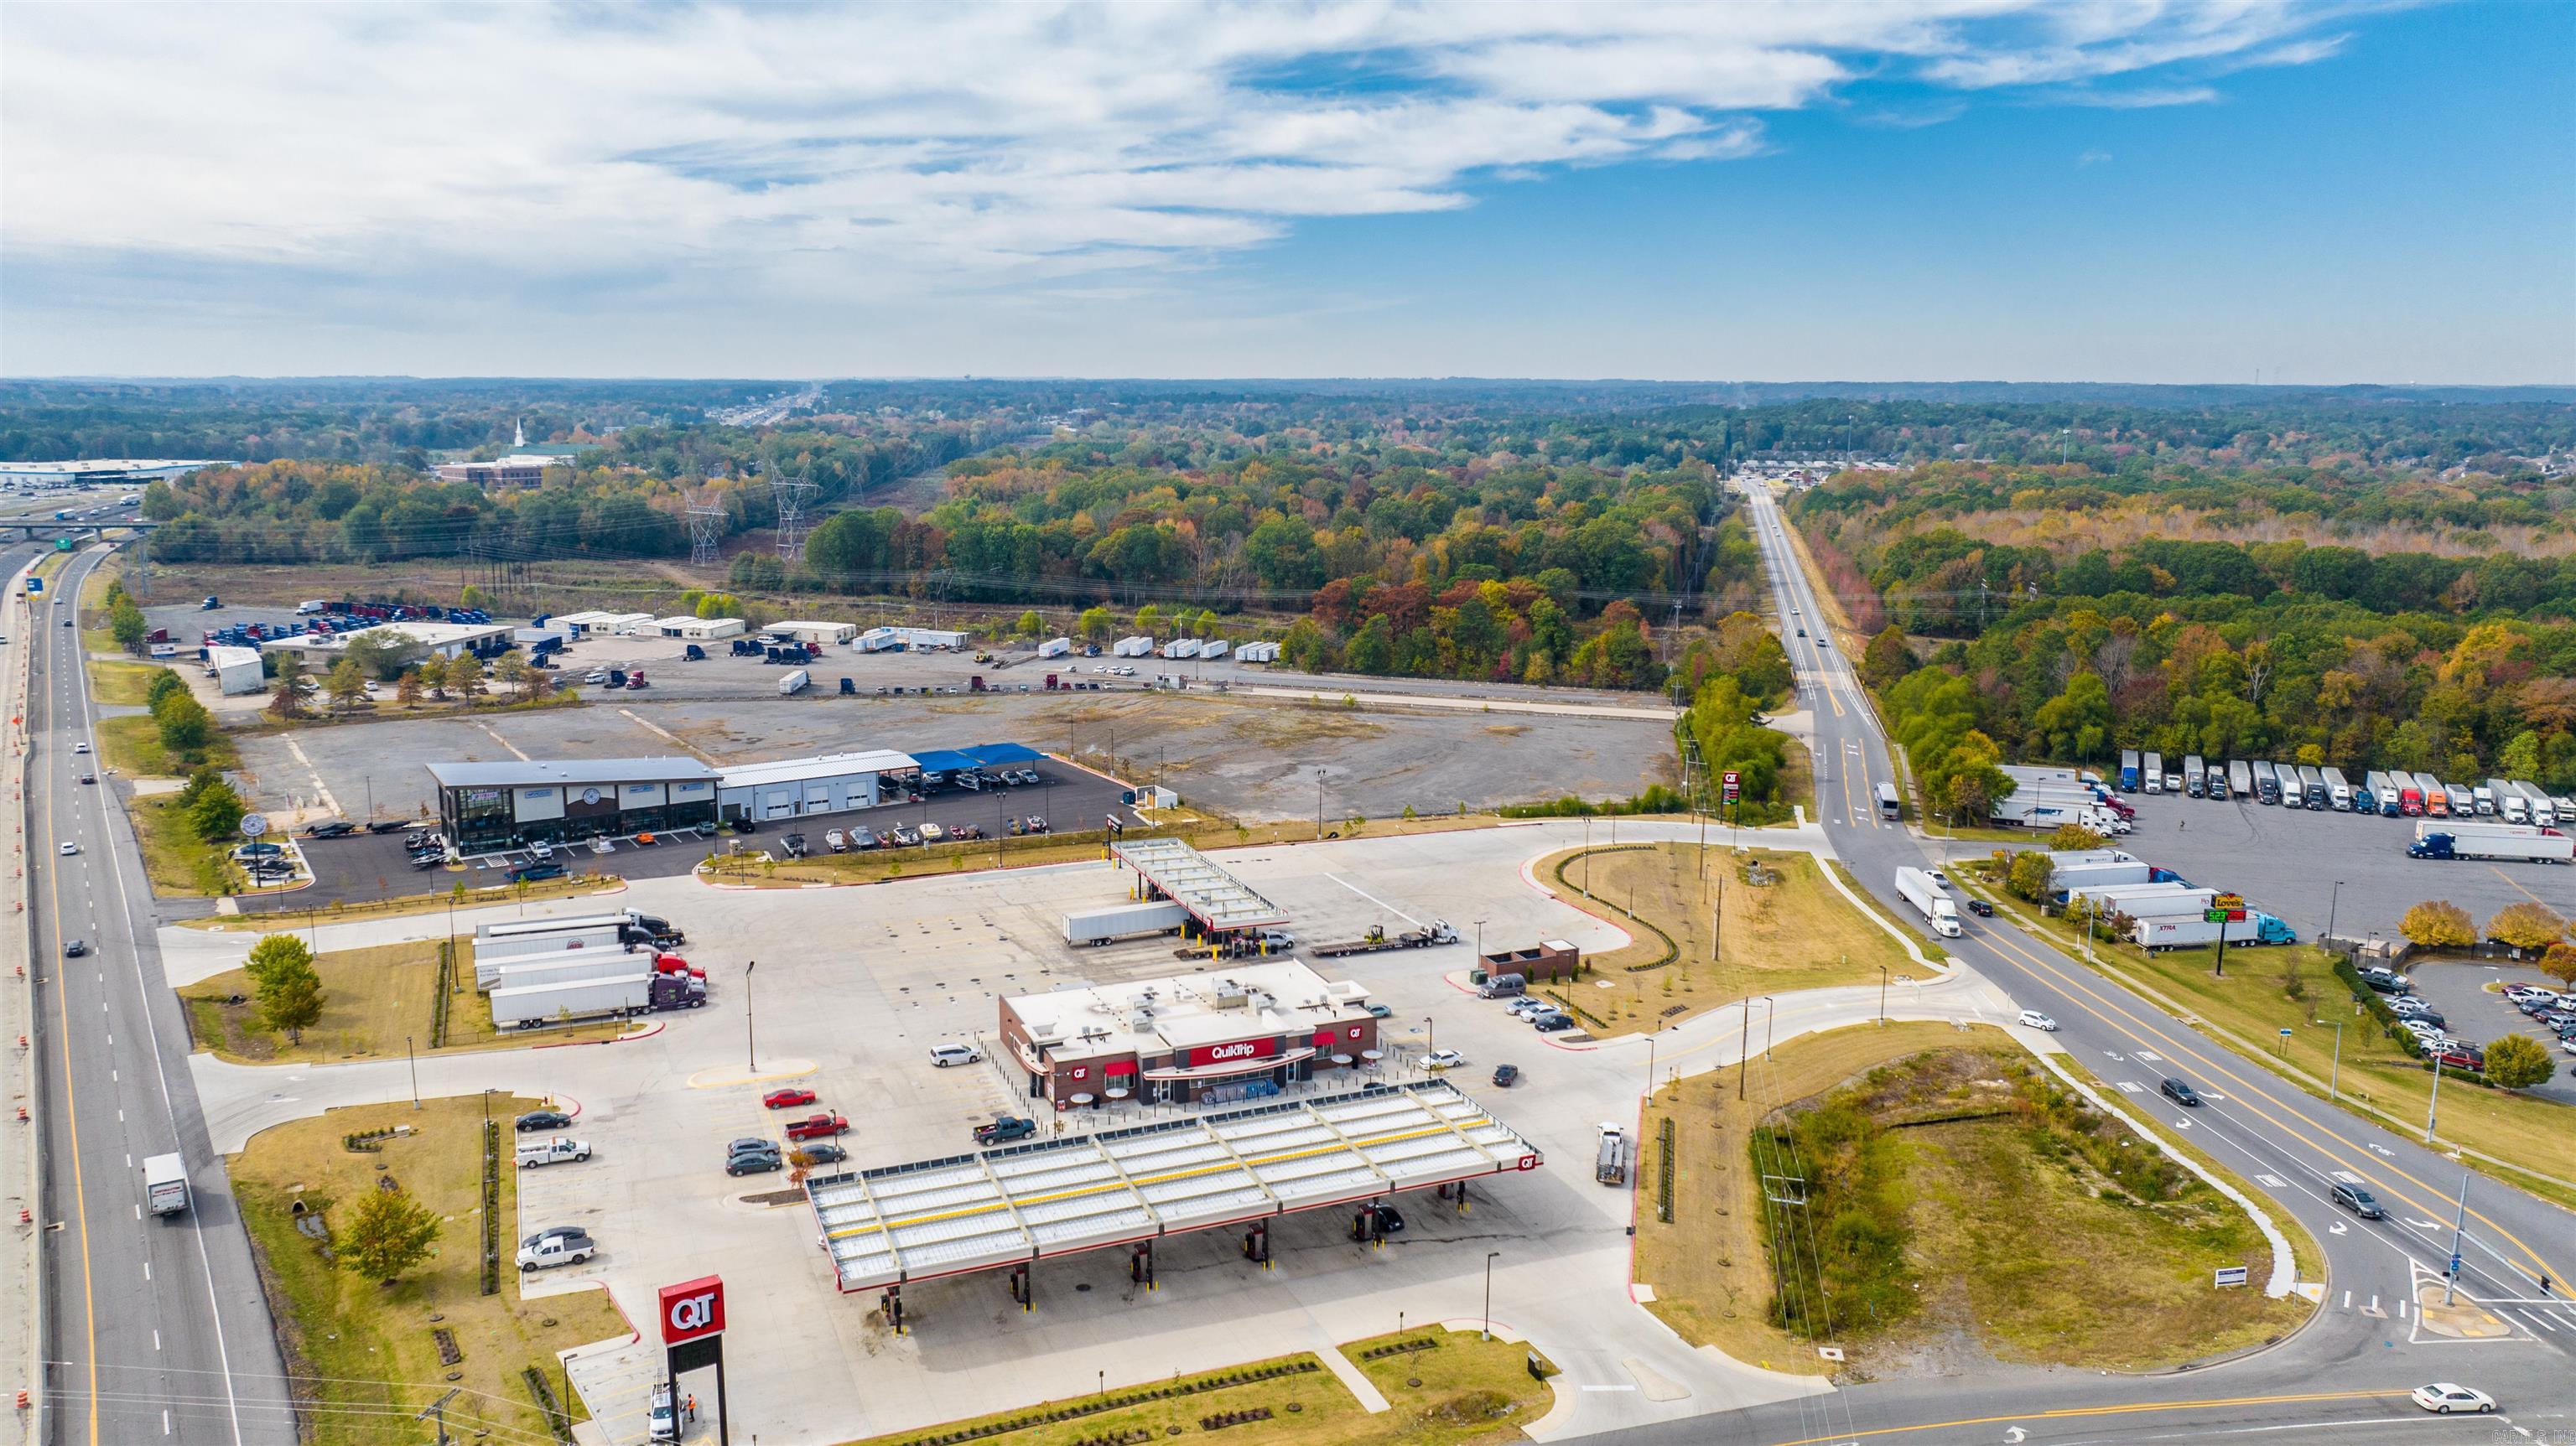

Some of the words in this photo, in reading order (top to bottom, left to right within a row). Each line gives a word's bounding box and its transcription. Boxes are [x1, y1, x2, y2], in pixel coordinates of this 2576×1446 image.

[1725, 774, 1737, 782] QT
[2034, 807, 2064, 816] SWIFT
[1350, 1028, 1361, 1038] QT
[1212, 1043, 1254, 1059] QuikTrip
[1074, 1068, 1086, 1078] QT
[1521, 1157, 1534, 1169] QT
[671, 1292, 714, 1330] QT
